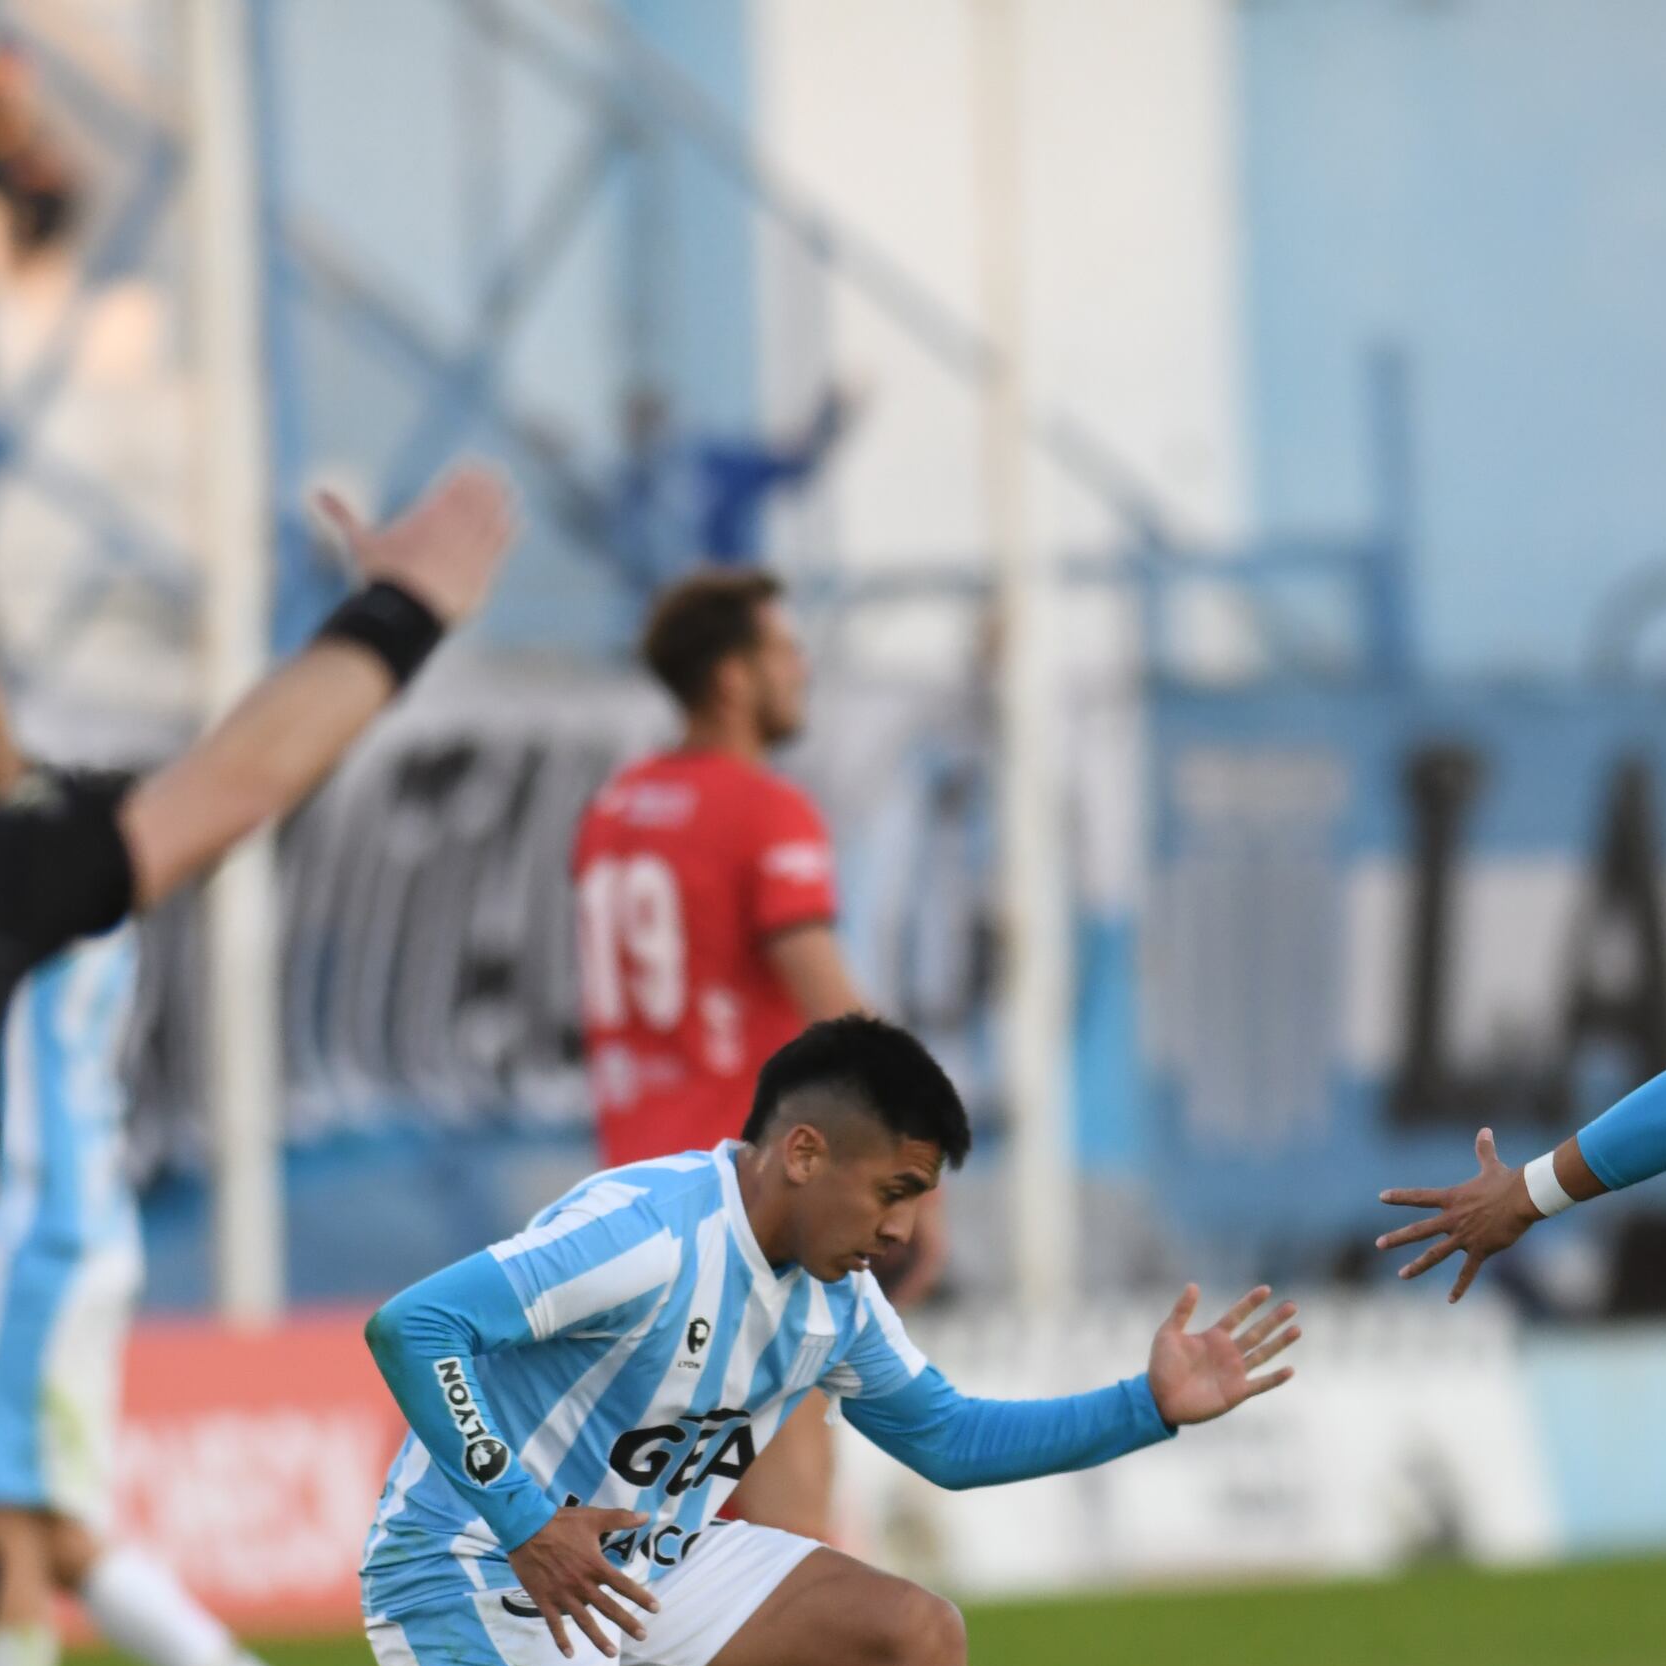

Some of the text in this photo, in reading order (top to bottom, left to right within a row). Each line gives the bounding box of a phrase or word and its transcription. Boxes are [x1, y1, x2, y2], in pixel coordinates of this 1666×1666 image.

[578, 858, 686, 1030] 19
[438, 1361, 486, 1440] LYON
[610, 1424, 756, 1496] GEA
